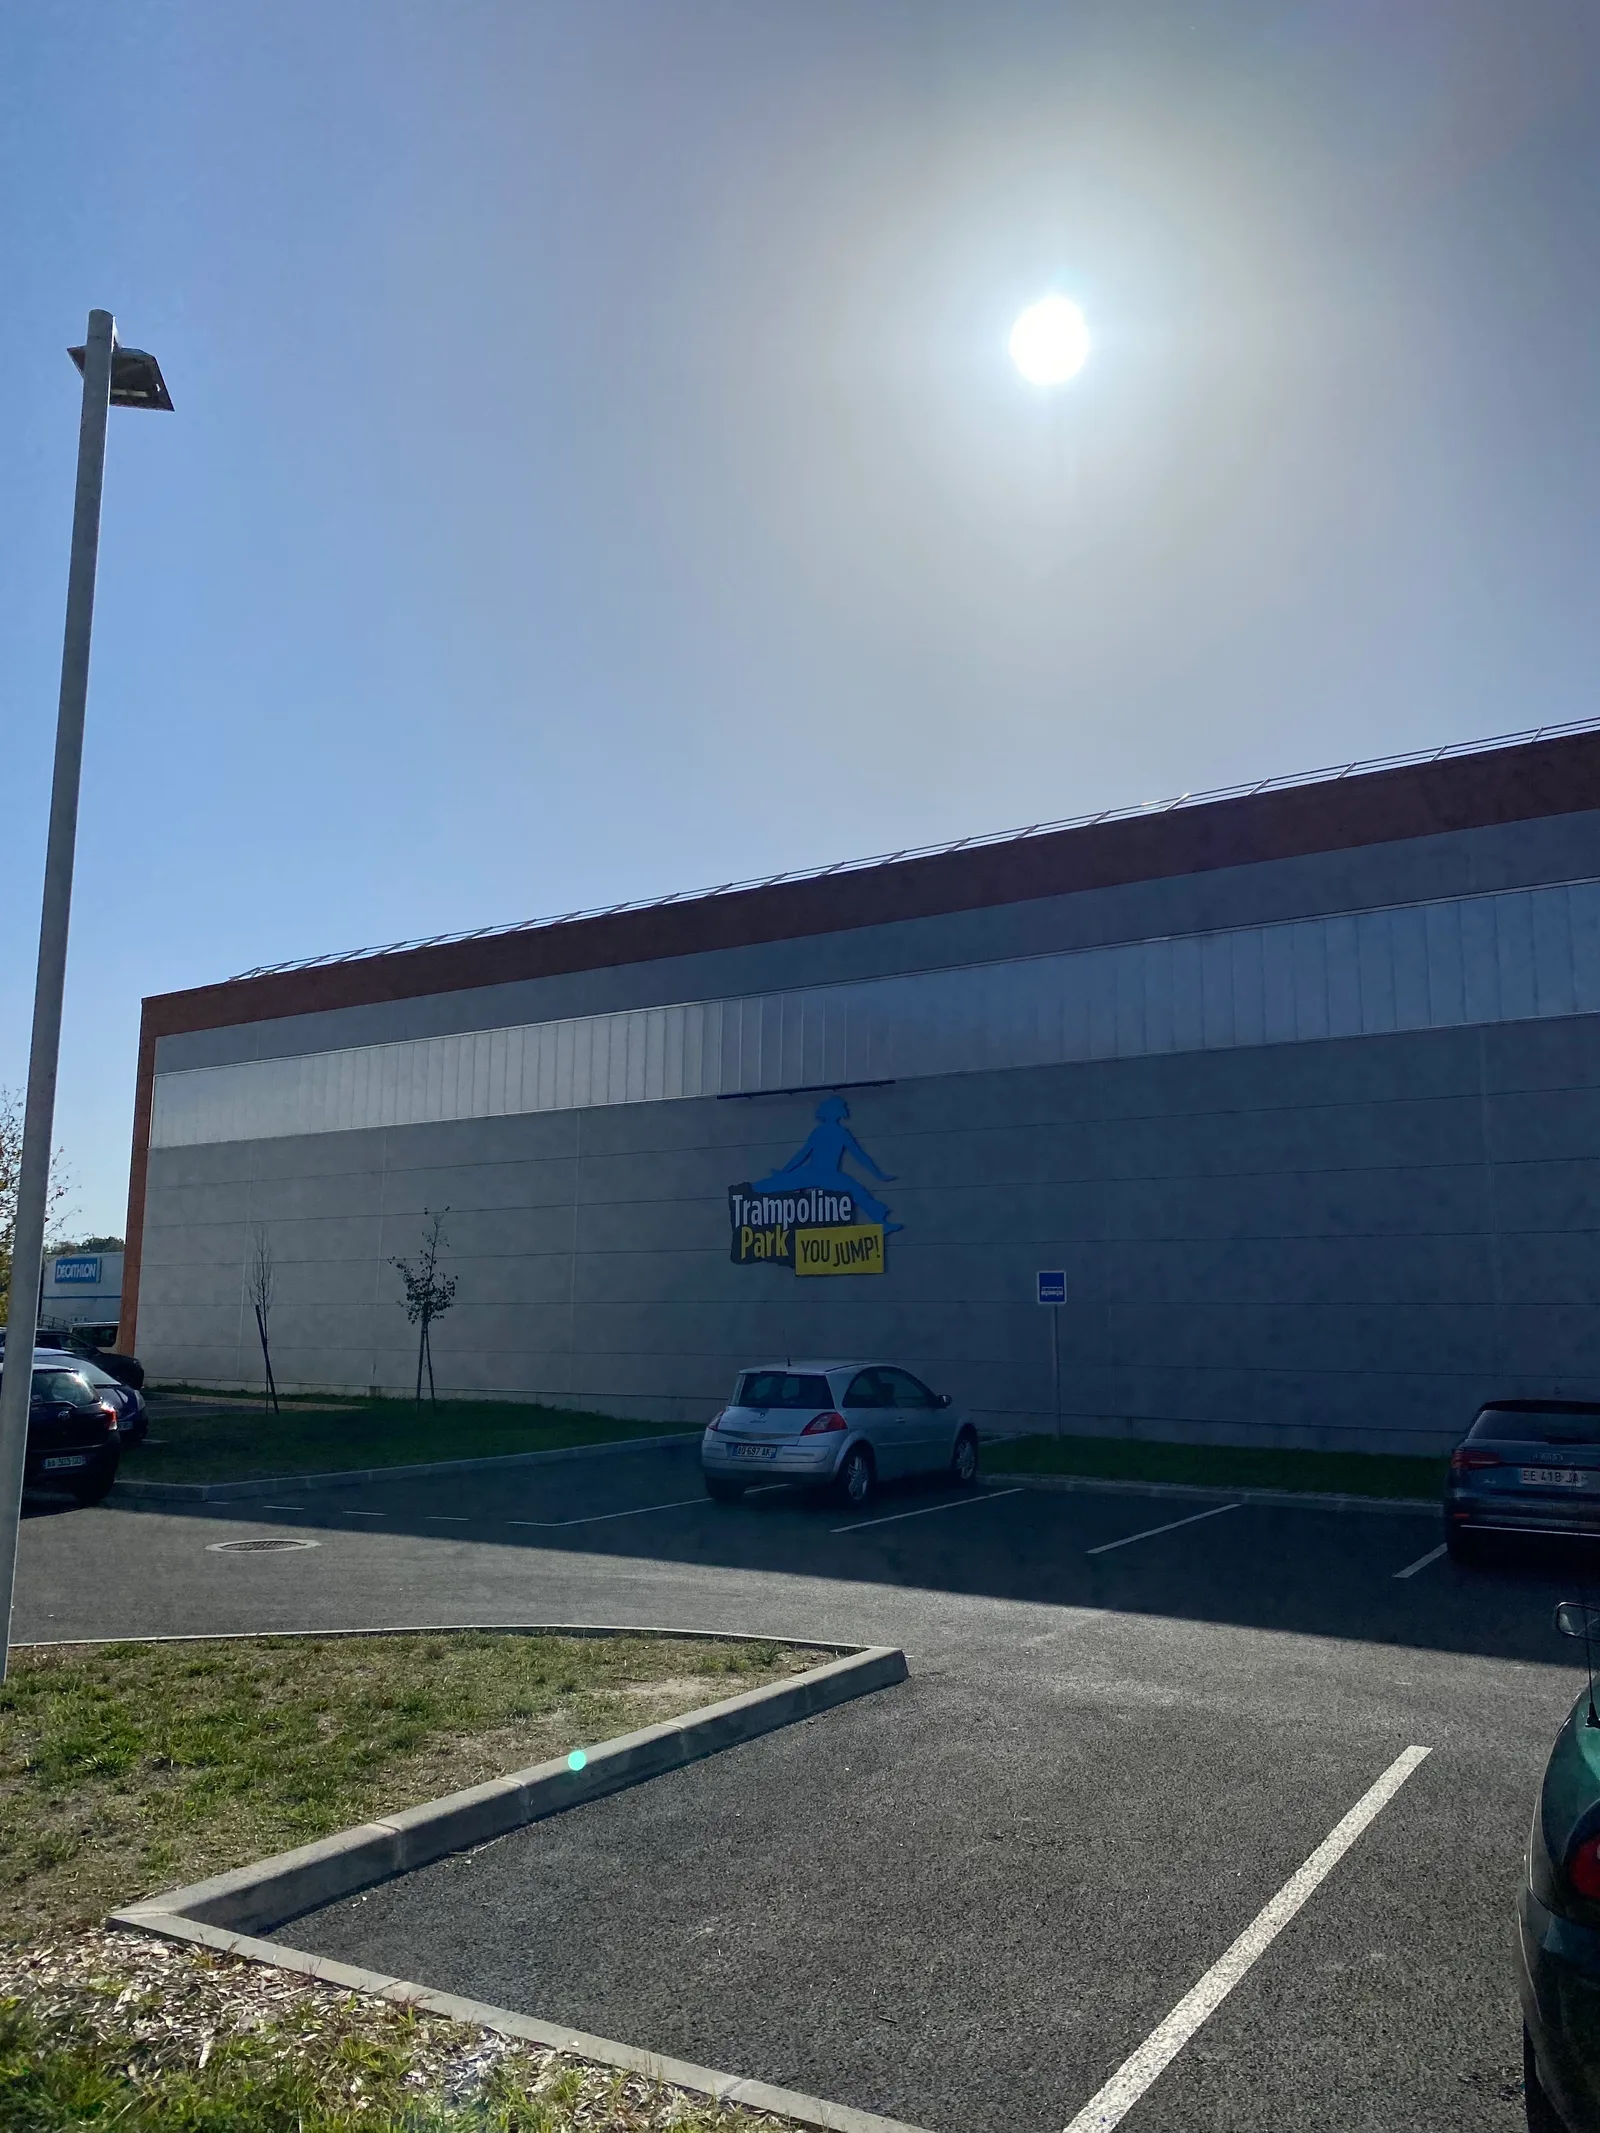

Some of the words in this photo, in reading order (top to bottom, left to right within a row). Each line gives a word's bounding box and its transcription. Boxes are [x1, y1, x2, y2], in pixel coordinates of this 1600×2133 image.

[732, 1190, 852, 1231] Trampoline
[741, 1225, 790, 1259] Park
[801, 1239, 830, 1263] YOU
[833, 1235, 881, 1267] JUMP!
[56, 1263, 97, 1279] DECATHLON
